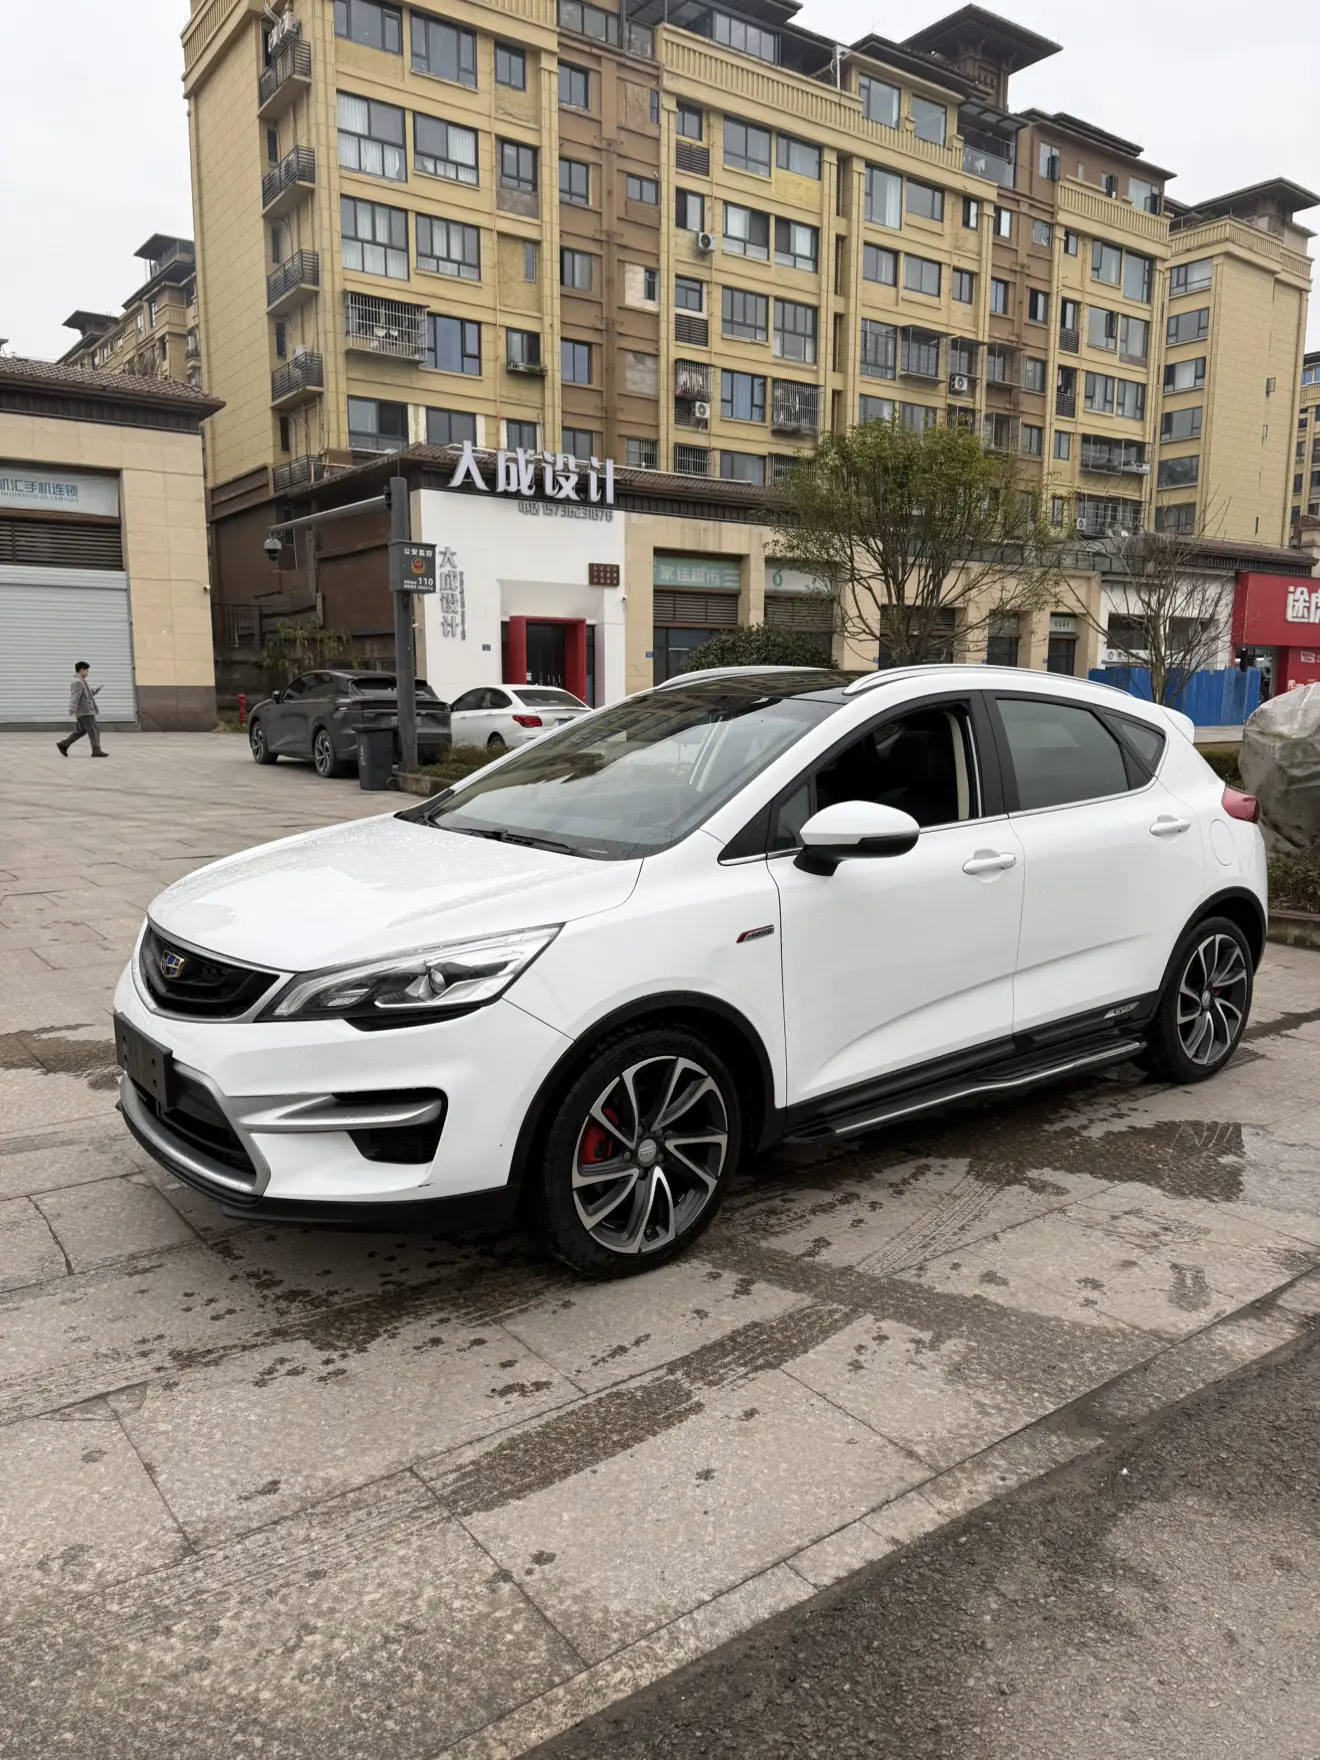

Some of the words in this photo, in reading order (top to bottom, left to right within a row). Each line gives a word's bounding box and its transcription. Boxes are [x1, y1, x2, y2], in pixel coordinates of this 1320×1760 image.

[447, 440, 619, 504] 大成设计
[418, 577, 434, 586] 110
[438, 546, 459, 638] 大成设计
